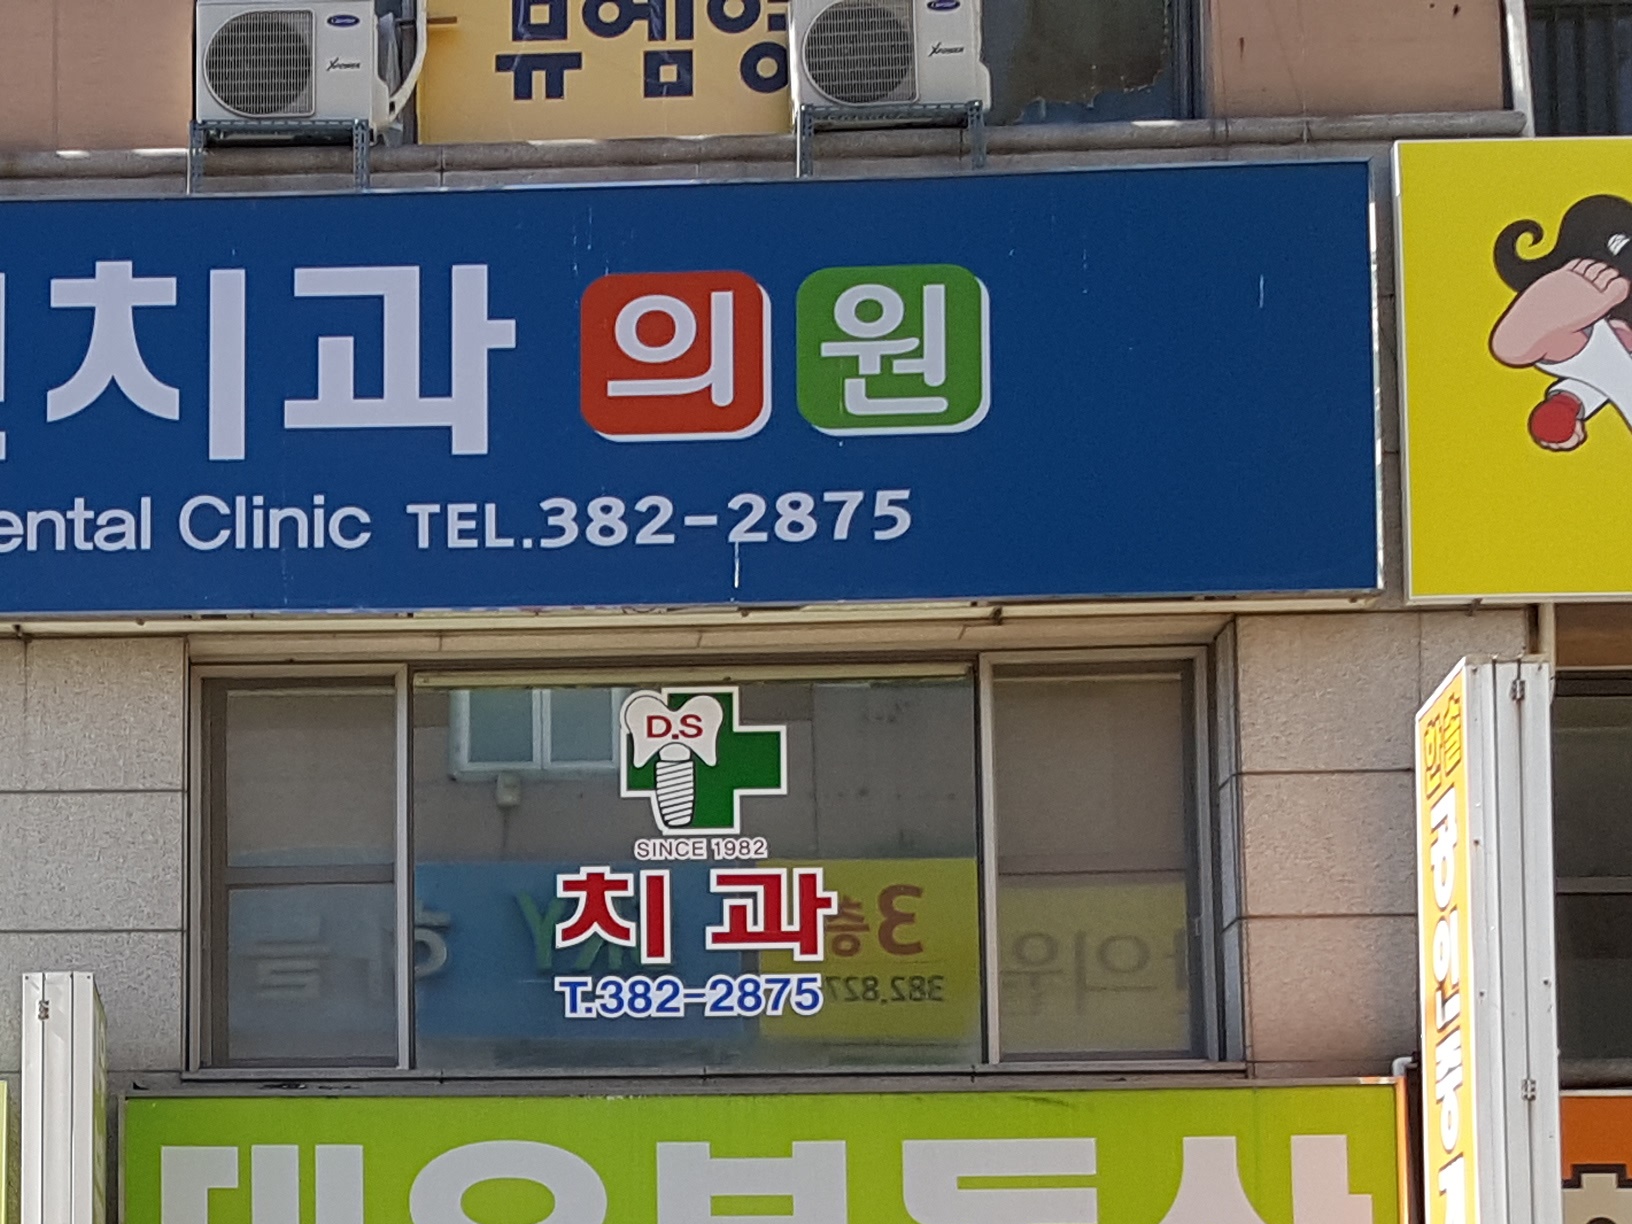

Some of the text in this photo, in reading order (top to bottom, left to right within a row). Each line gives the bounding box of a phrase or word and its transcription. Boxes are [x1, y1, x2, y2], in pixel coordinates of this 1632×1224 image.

[179, 495, 372, 550] Clinic
[646, 712, 705, 741] D.S
[635, 838, 768, 860] SINCE 1982
[556, 976, 823, 1017] T.382-2875
